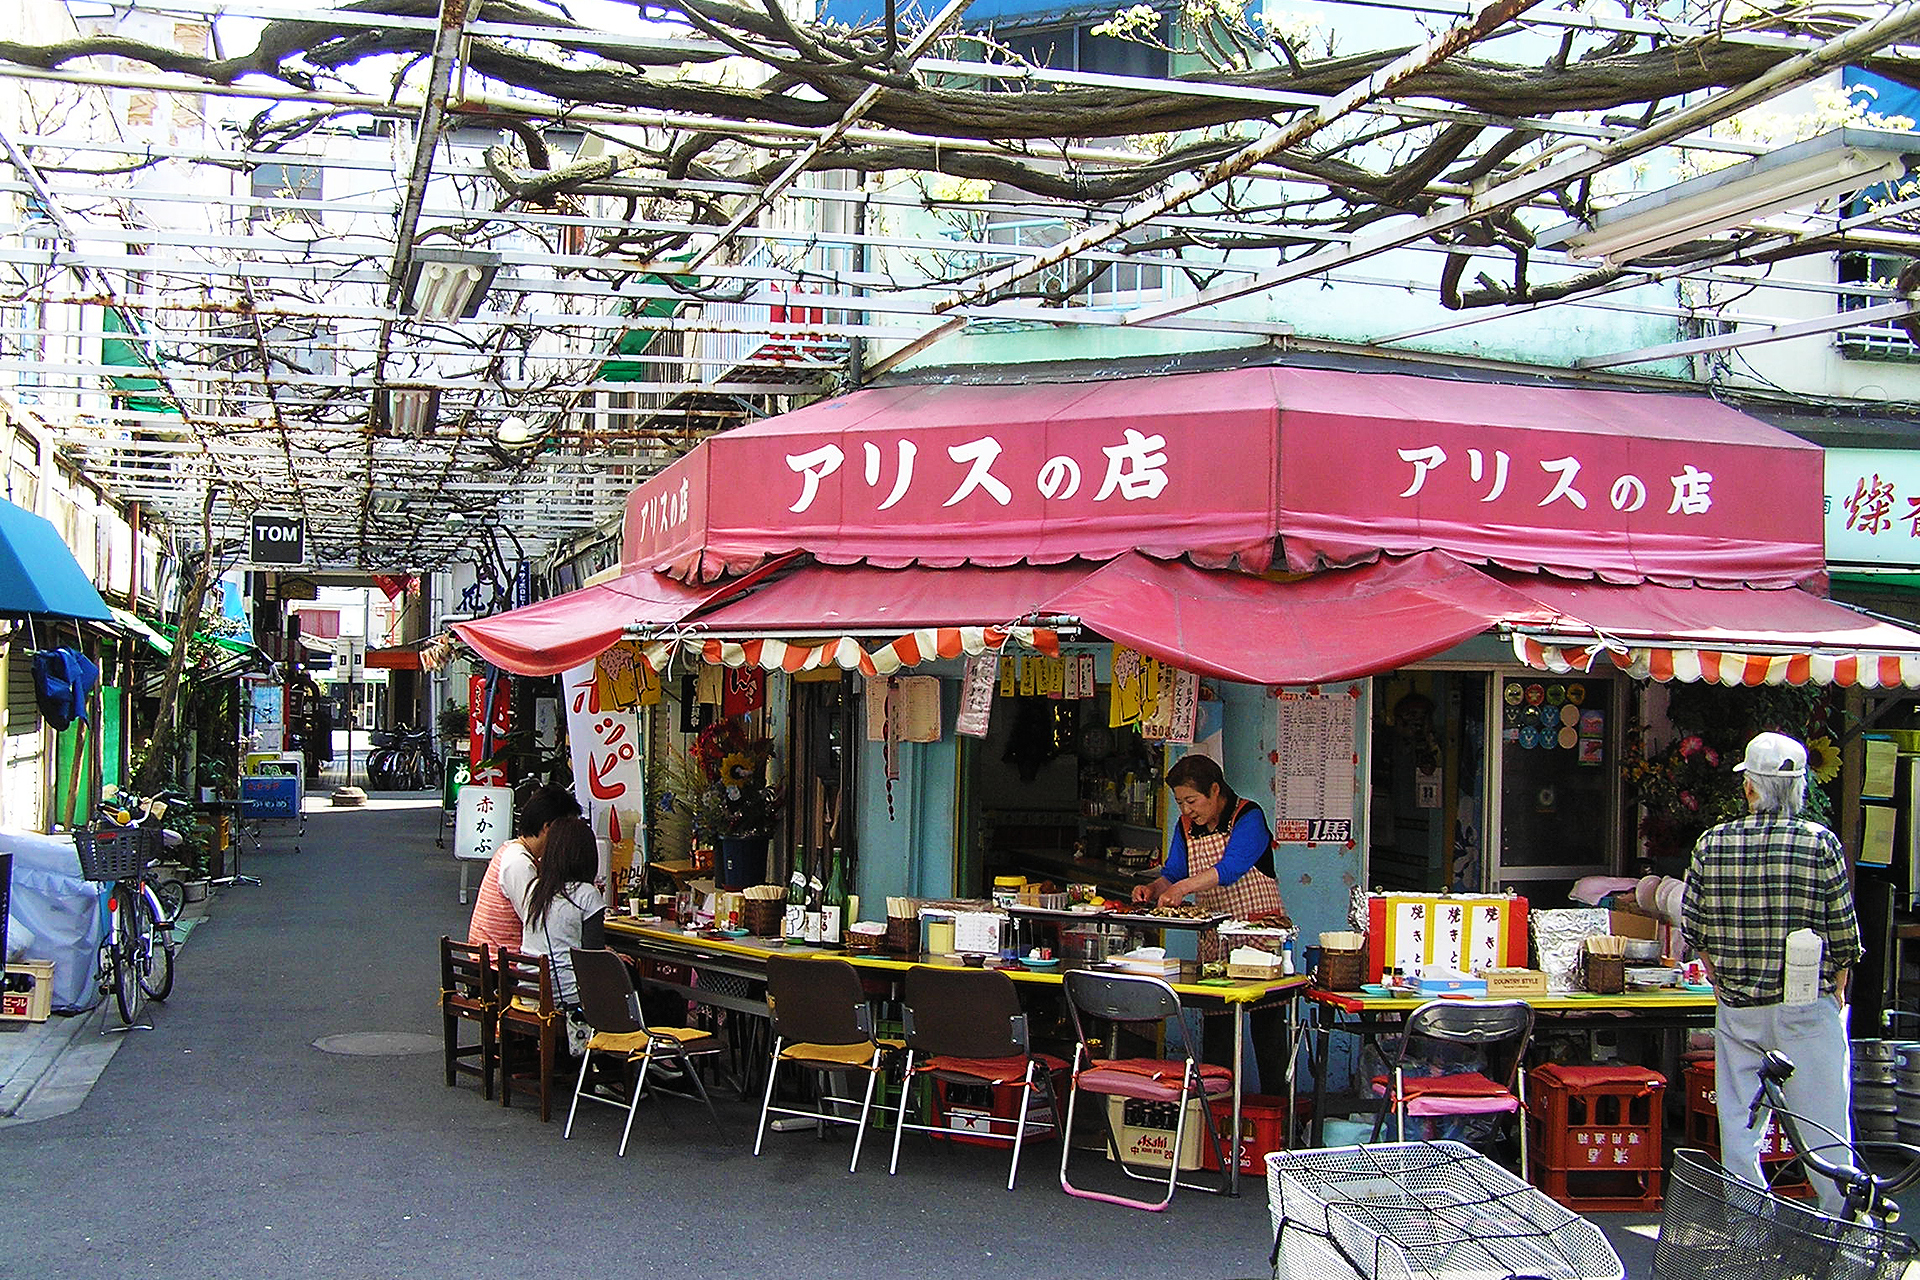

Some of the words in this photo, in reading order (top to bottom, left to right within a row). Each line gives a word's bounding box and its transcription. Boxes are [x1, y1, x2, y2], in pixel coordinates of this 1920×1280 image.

[786, 428, 1168, 513] アリスの店
[1398, 446, 1713, 517] アリスの店
[256, 526, 297, 542] TOM
[640, 477, 688, 542] アリスの店
[474, 796, 494, 853] 赤かぶ
[1447, 906, 1462, 970] 焼きと
[1137, 1134, 1168, 1149] Asahi
